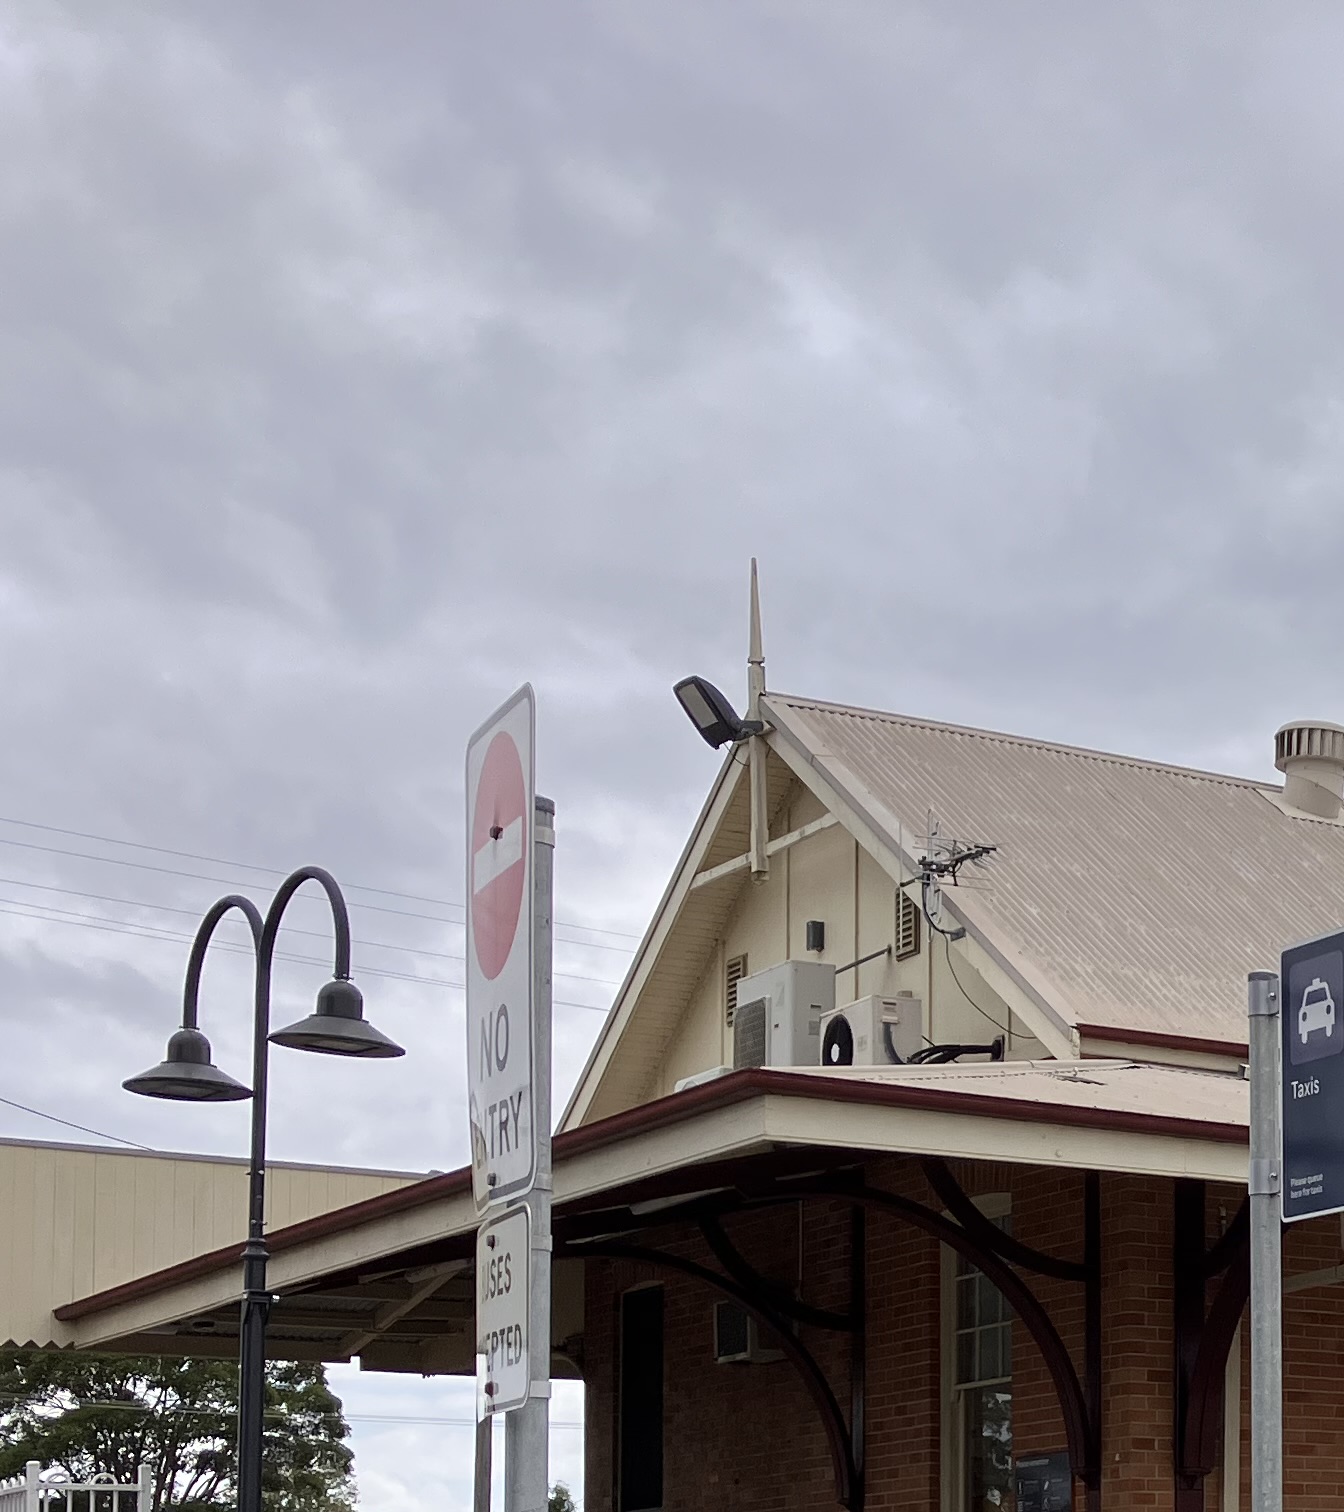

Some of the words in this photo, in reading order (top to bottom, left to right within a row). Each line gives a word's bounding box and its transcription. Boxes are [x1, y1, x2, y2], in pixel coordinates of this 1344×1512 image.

[480, 1004, 509, 1083] NO
[1291, 1075, 1320, 1100] Taxis
[481, 1251, 512, 1304] USES
[478, 1323, 523, 1373] EPTED
